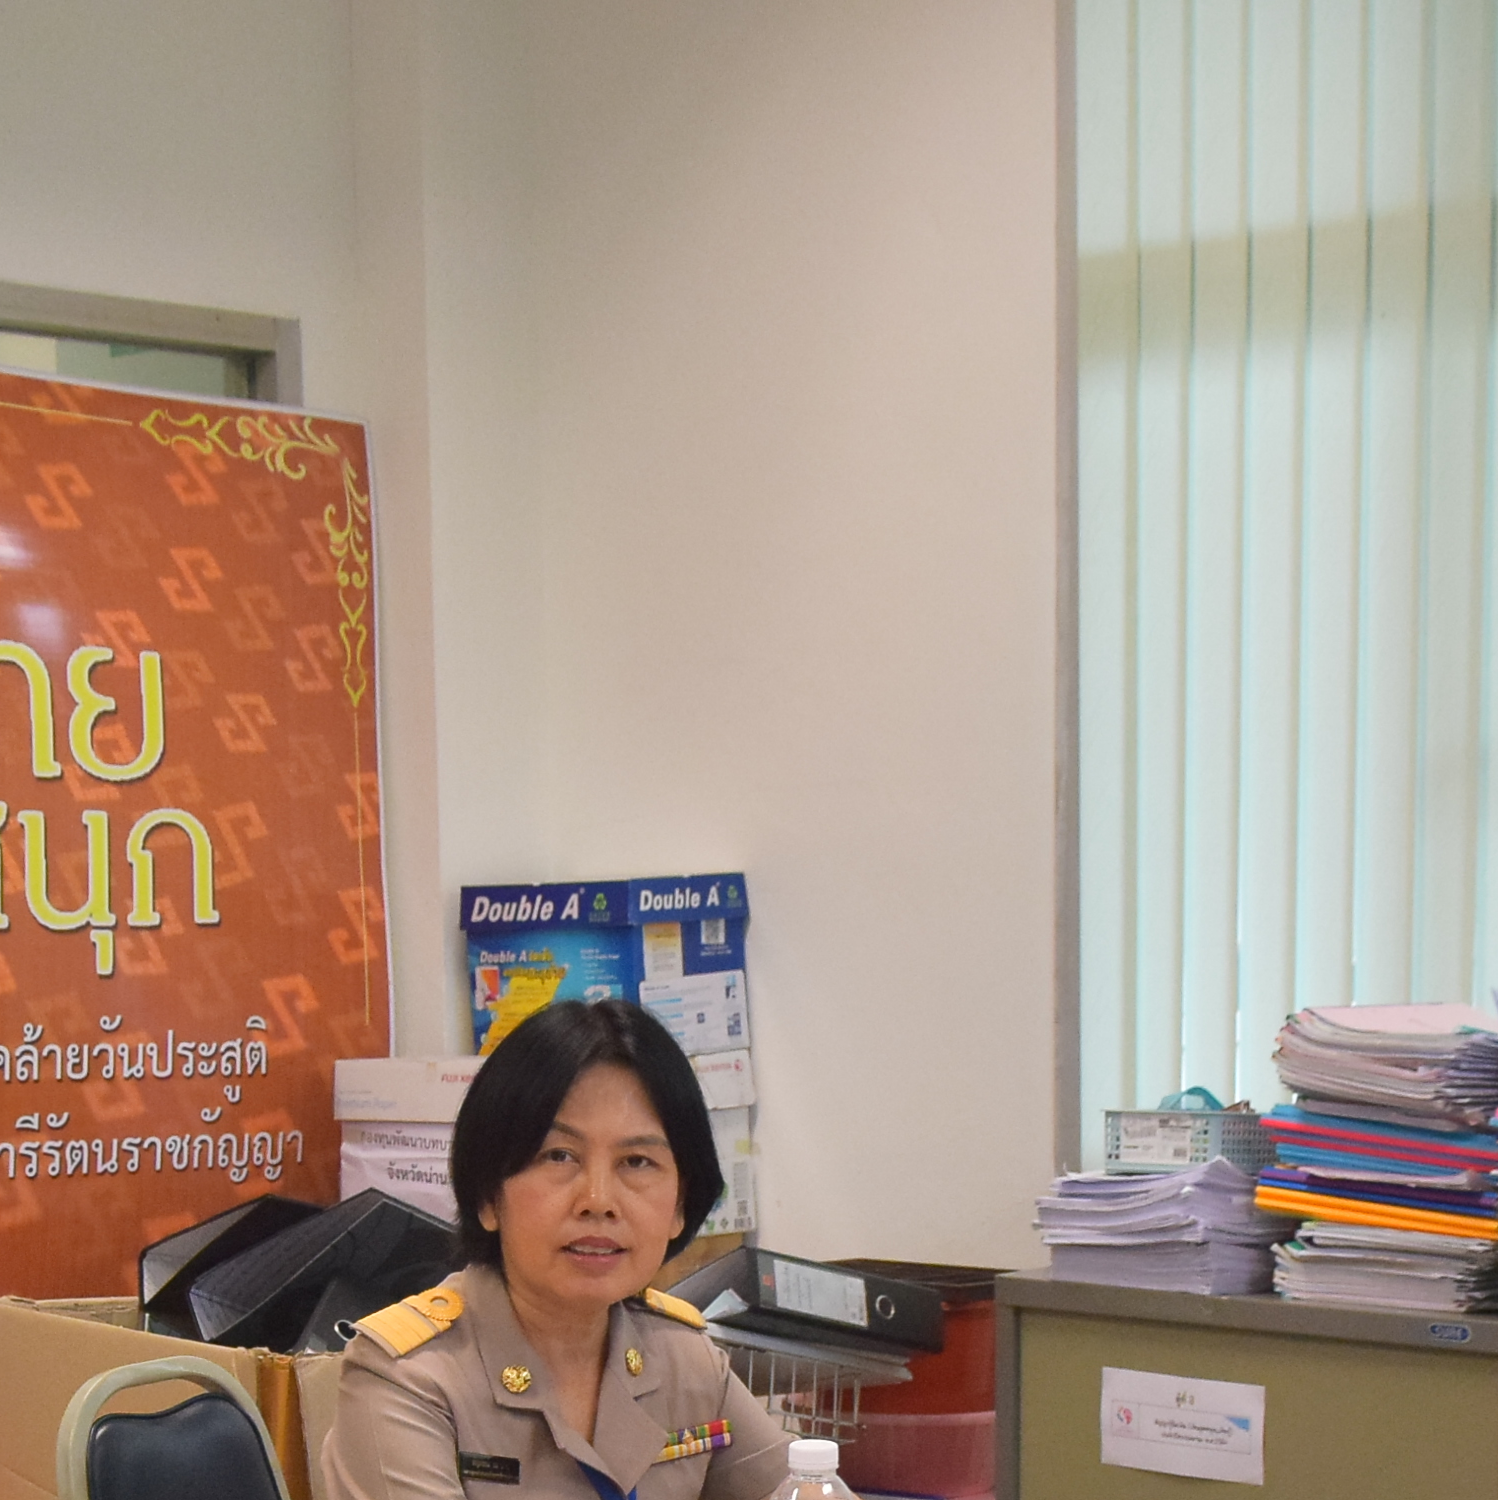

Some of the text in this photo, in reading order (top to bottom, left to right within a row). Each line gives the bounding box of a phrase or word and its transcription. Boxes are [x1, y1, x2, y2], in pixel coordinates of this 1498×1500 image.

[470, 890, 580, 923] Double A
[639, 885, 721, 912] Double A
[479, 951, 516, 964] Double
